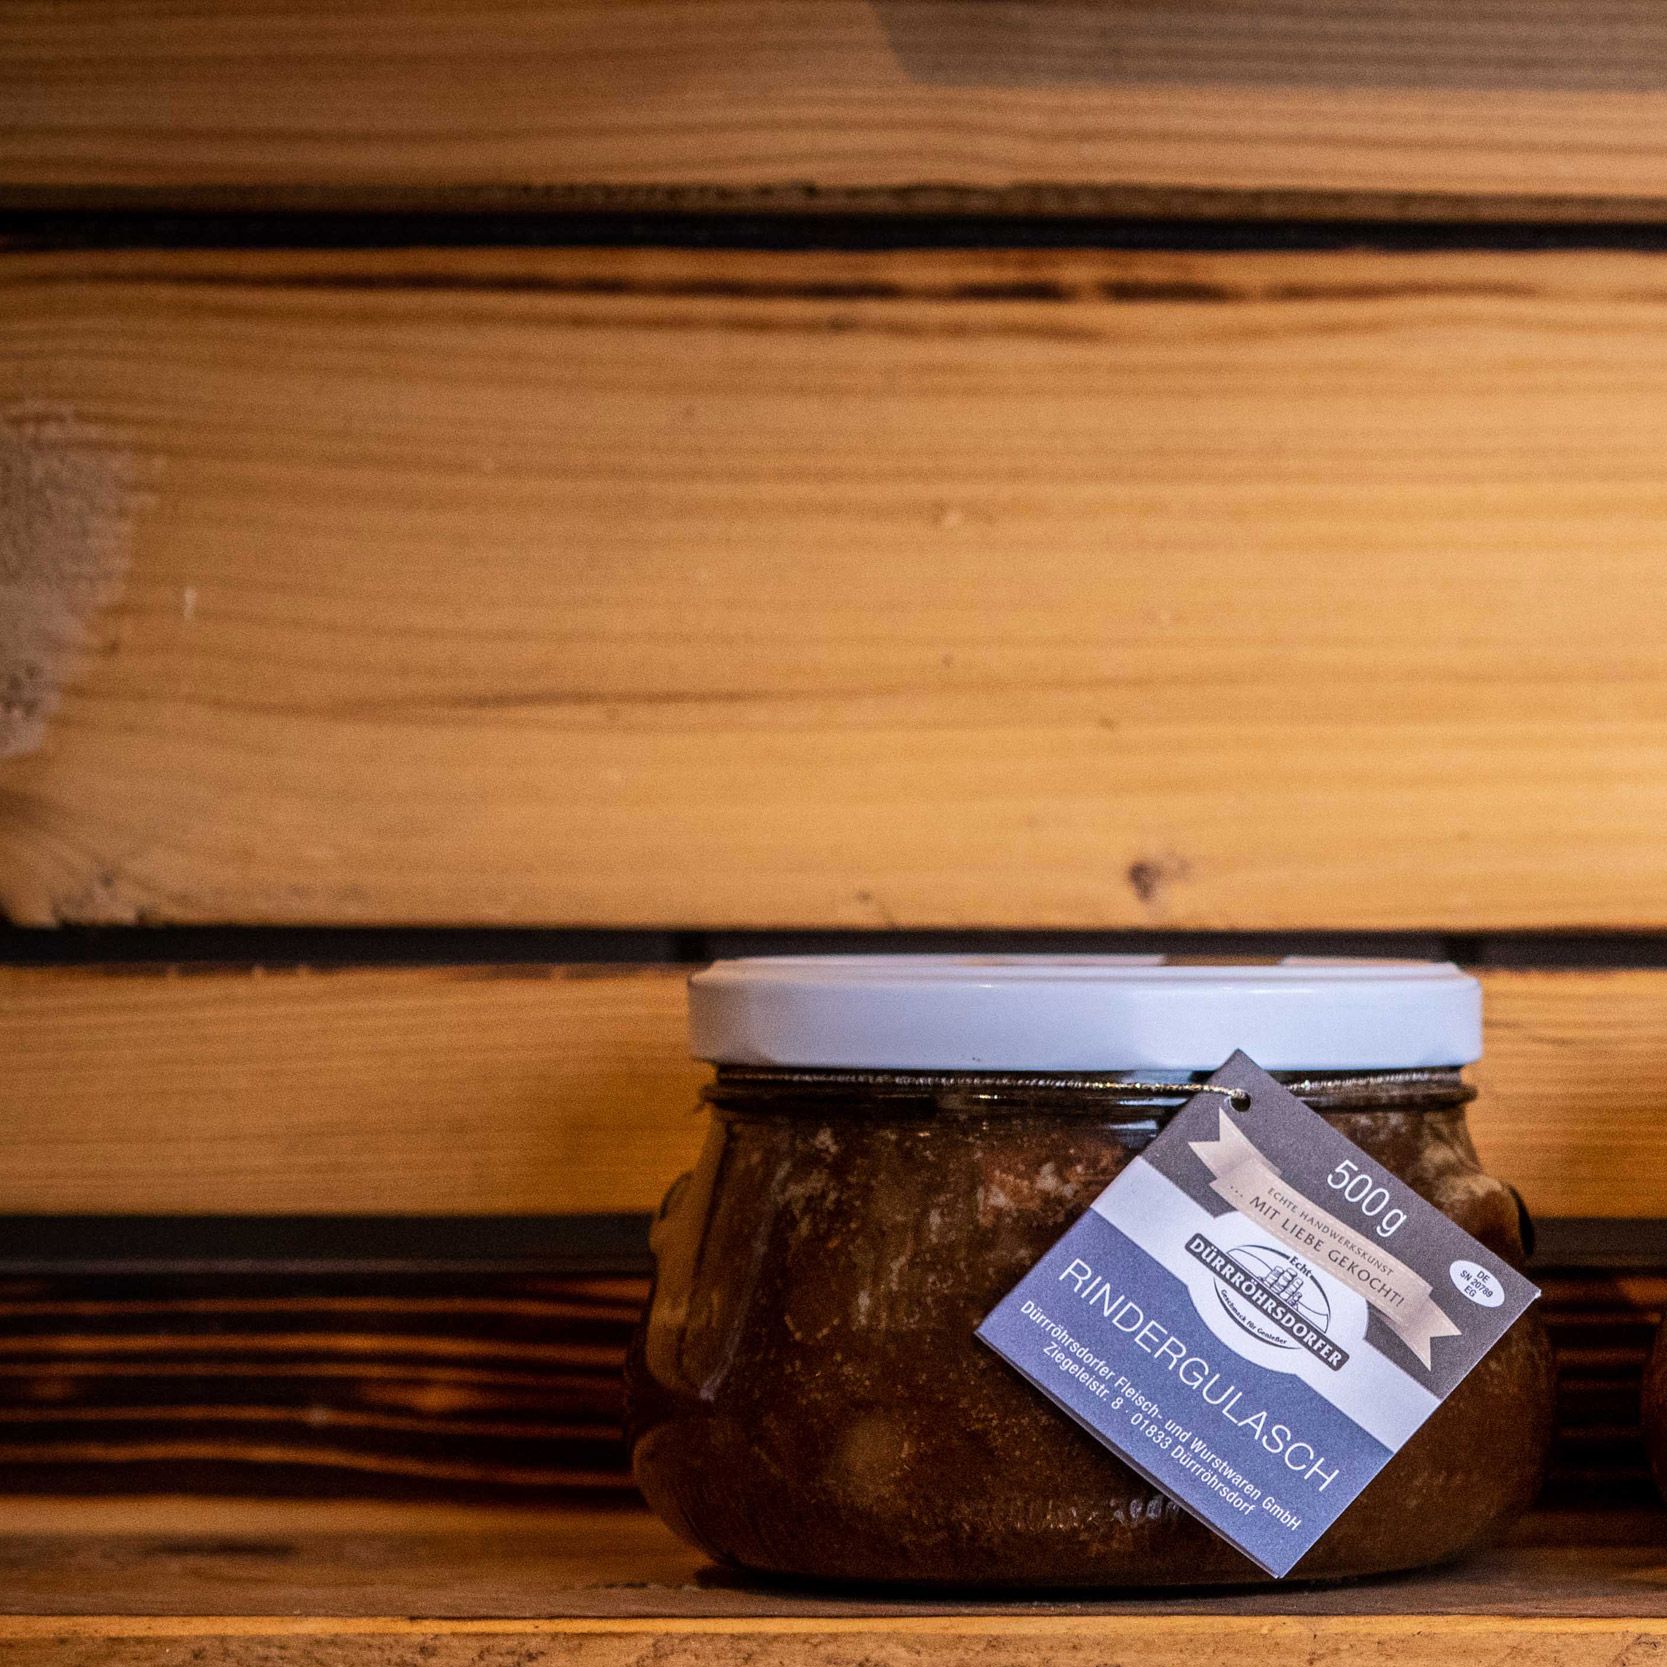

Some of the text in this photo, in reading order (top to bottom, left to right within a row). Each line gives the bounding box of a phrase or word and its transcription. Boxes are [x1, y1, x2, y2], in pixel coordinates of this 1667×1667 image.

[1249, 1195, 1281, 1220] MIT
[1281, 1218, 1325, 1253] LIEBE
[1327, 1249, 1405, 1308] GEKOCHT!
[1267, 1187, 1394, 1276] ECHTE HANDWERKSKUNST
[1289, 1255, 1313, 1279] Echt
[1189, 1237, 1347, 1367] DÜRRRÖHRSDORFER
[1218, 1289, 1247, 1323] Geschmack
[1244, 1320, 1257, 1331] für
[1460, 1269, 1494, 1298] SN 20789
[1463, 1284, 1477, 1298] EG
[1476, 1270, 1491, 1283] DE
[1020, 1300, 1302, 1531] Dürrröhrsdorfer Fleisch- und Wurstwaren GmbH
[1058, 1257, 1340, 1492] RINDERGULASCH
[1042, 1340, 1110, 1402] Ziegeleistr.
[1110, 1396, 1124, 1410] 8
[1130, 1412, 1173, 1450] 01833
[1170, 1444, 1256, 1516] Dürrröhrsdorf
